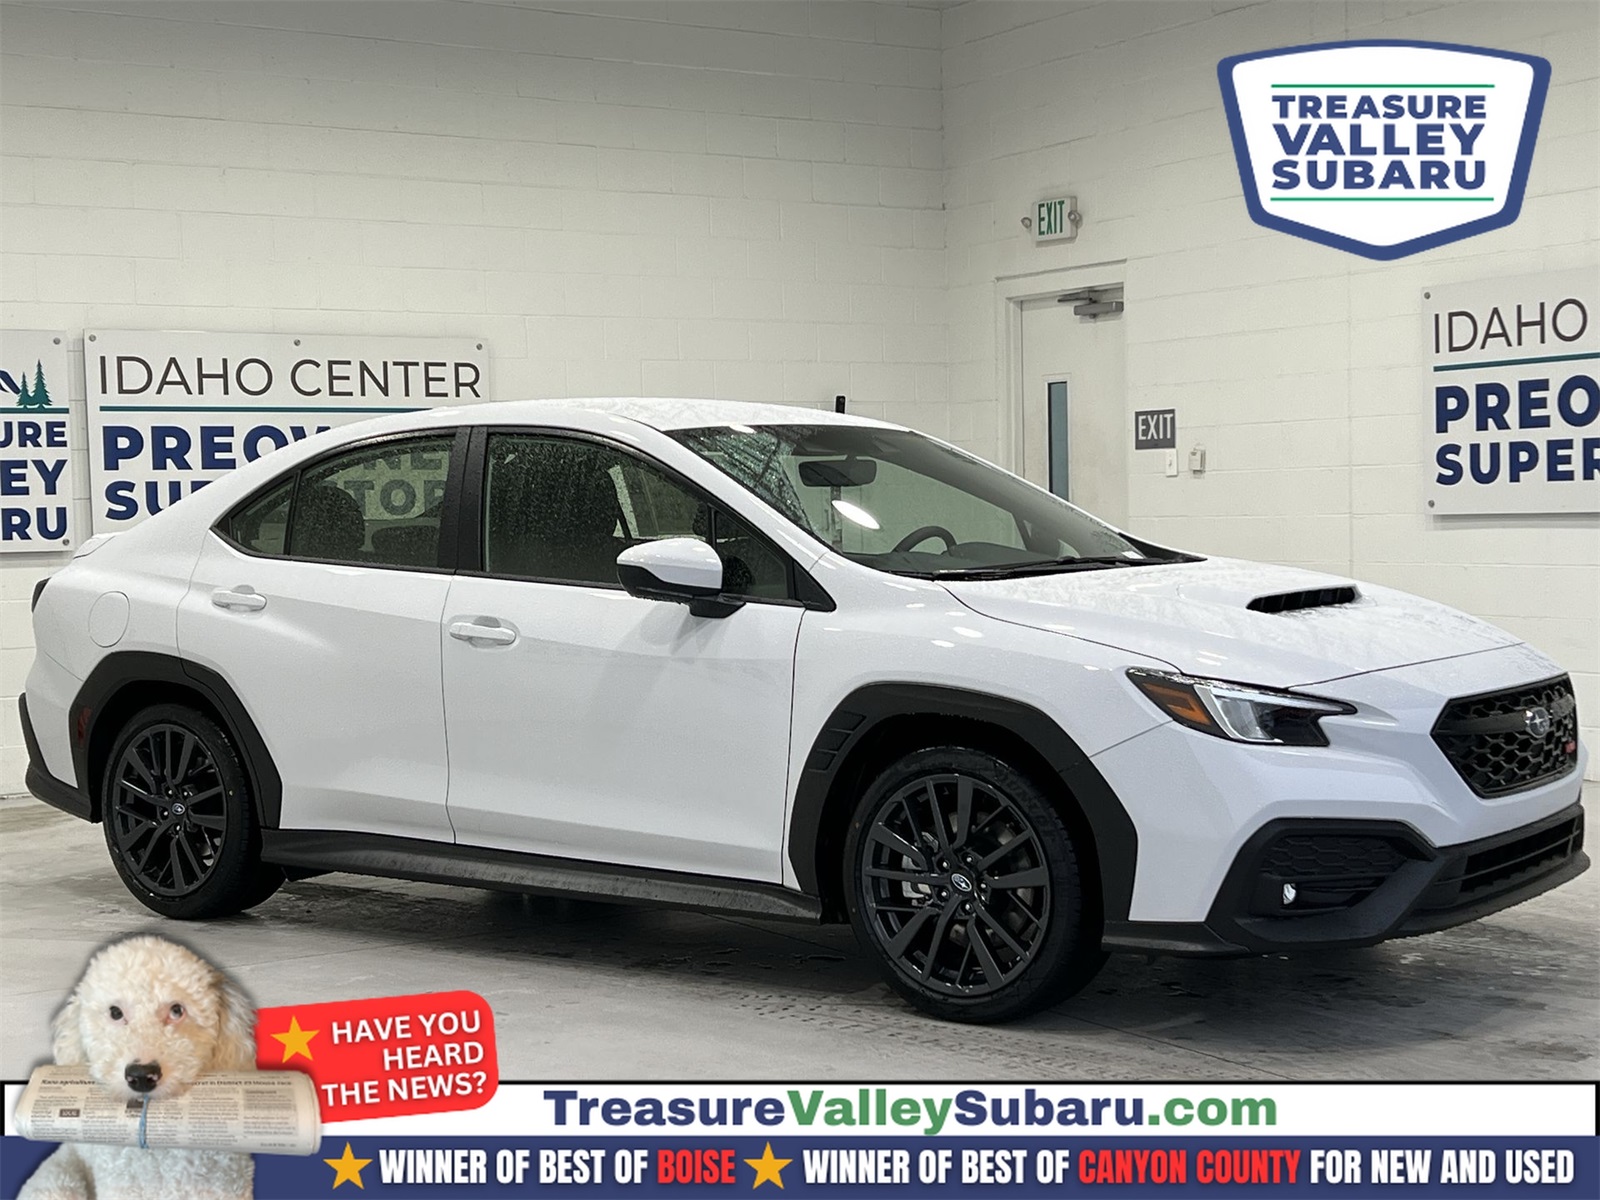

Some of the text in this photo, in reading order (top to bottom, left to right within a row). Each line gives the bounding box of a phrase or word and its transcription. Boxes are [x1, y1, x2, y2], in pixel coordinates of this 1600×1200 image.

[1038, 200, 1065, 236] EXIT
[1434, 298, 1588, 354] IDAHO
[99, 355, 482, 398] IDAHO CENTER
[1138, 413, 1174, 440] EXIT
[102, 425, 331, 471] PREO
[105, 480, 213, 521] SU
